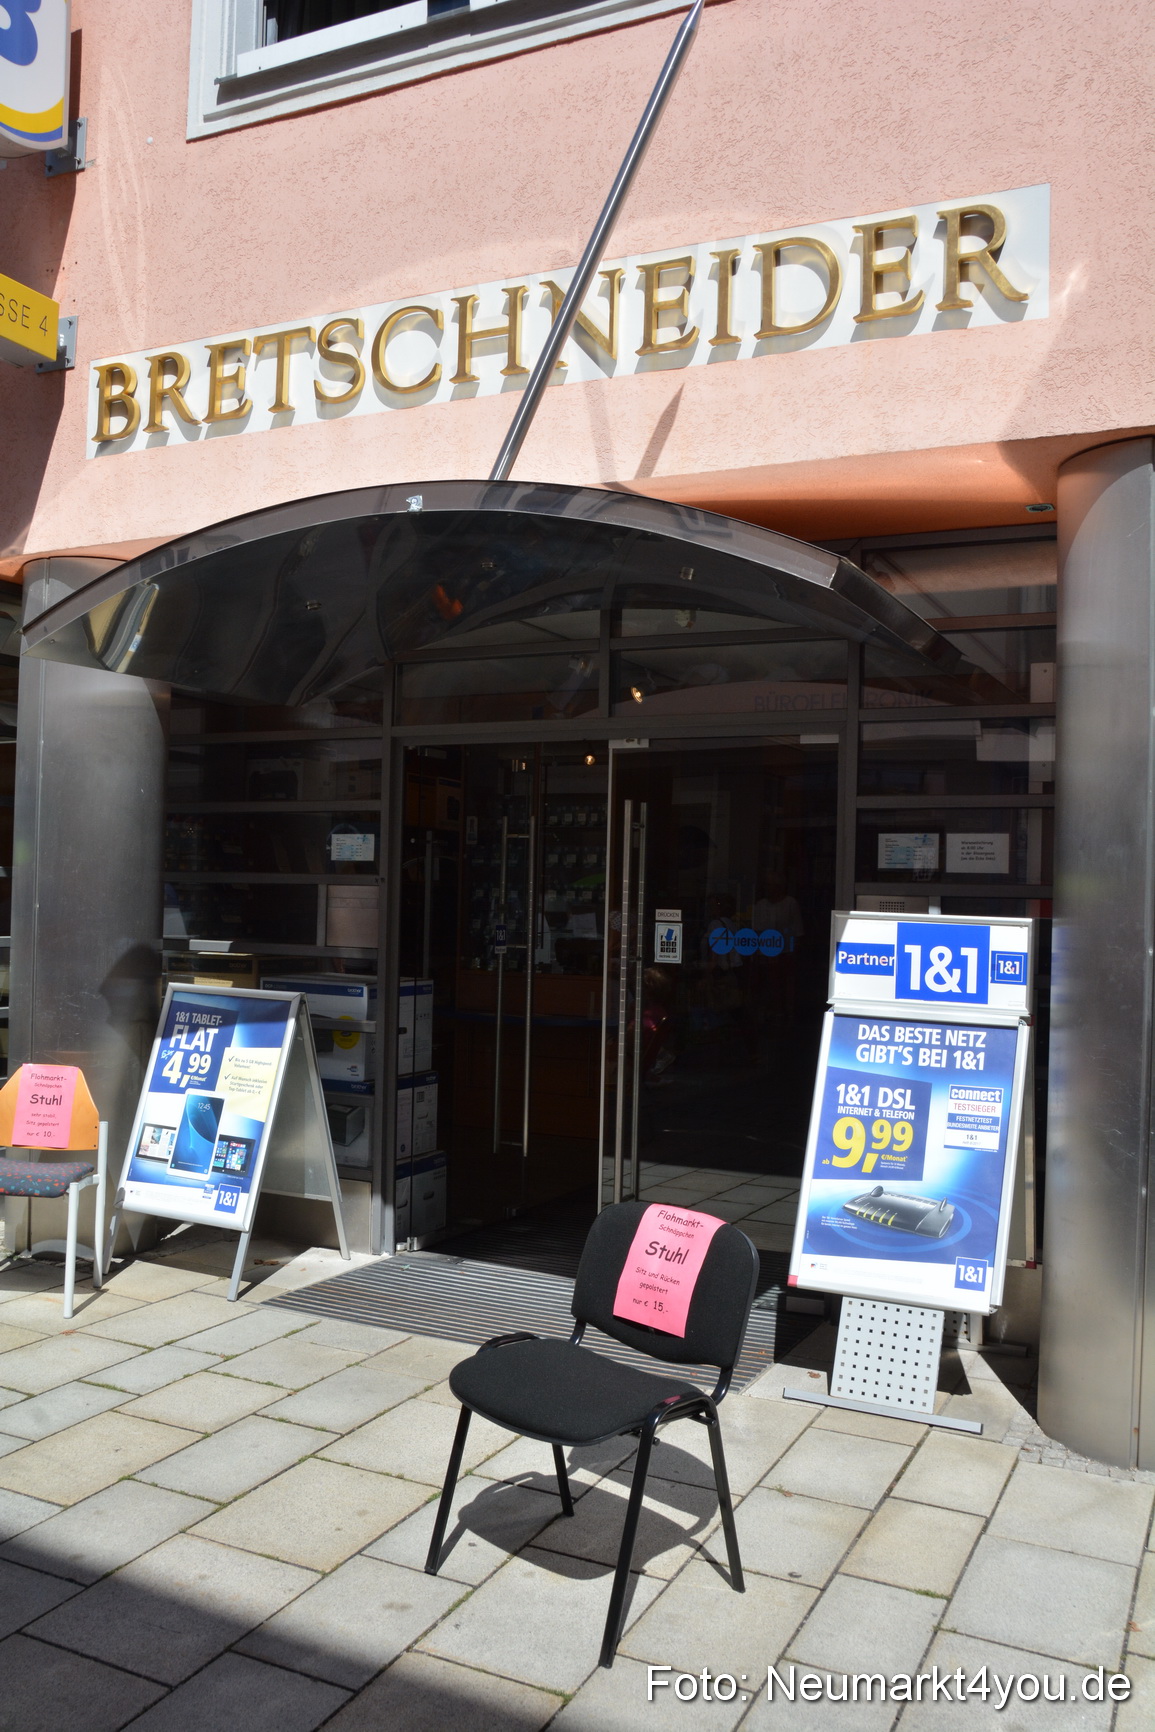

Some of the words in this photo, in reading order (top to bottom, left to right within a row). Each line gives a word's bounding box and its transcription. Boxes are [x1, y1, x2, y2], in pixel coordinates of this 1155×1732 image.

[39, 315, 48, 336] 4
[92, 203, 1029, 443] BRETSCHNEIDER
[709, 928, 782, 948] Auerswald
[838, 951, 894, 967] Partner
[998, 960, 1020, 975] 1&1
[904, 944, 978, 994] 1&1
[176, 1011, 189, 1022] 1&1
[192, 1013, 222, 1026] TABLET-
[169, 1024, 219, 1052] FLAT
[858, 1024, 890, 1042] DAS
[894, 1026, 941, 1046] BESTE
[945, 1029, 987, 1048] NETZ
[855, 1044, 913, 1066] GIBT'S
[918, 1048, 947, 1068] BEI
[953, 1050, 985, 1071] 1&1
[31, 1073, 67, 1081] Flohmarkt-
[30, 1094, 62, 1105] Stuhl
[836, 1083, 870, 1107] 1&1
[877, 1086, 916, 1110] DSL
[951, 1088, 1001, 1102] connect
[837, 1105, 873, 1117] INTERNET
[874, 1109, 880, 1117] &
[882, 1109, 915, 1120] TELEFON
[954, 1103, 996, 1113] TESTSIEGER
[956, 1115, 992, 1123] FESTNETZTEST
[831, 1116, 914, 1173] 9,99
[218, 1191, 237, 1207] 1&1
[657, 1210, 704, 1229] Flohmarkt-
[659, 1224, 694, 1239] Schnäppchen
[645, 1241, 689, 1265] Stuhl
[635, 1267, 647, 1276] Sitz
[648, 1271, 658, 1279] und
[660, 1274, 680, 1286] Rücken
[958, 1264, 983, 1283] 1&1
[639, 1282, 668, 1295] gepolstert
